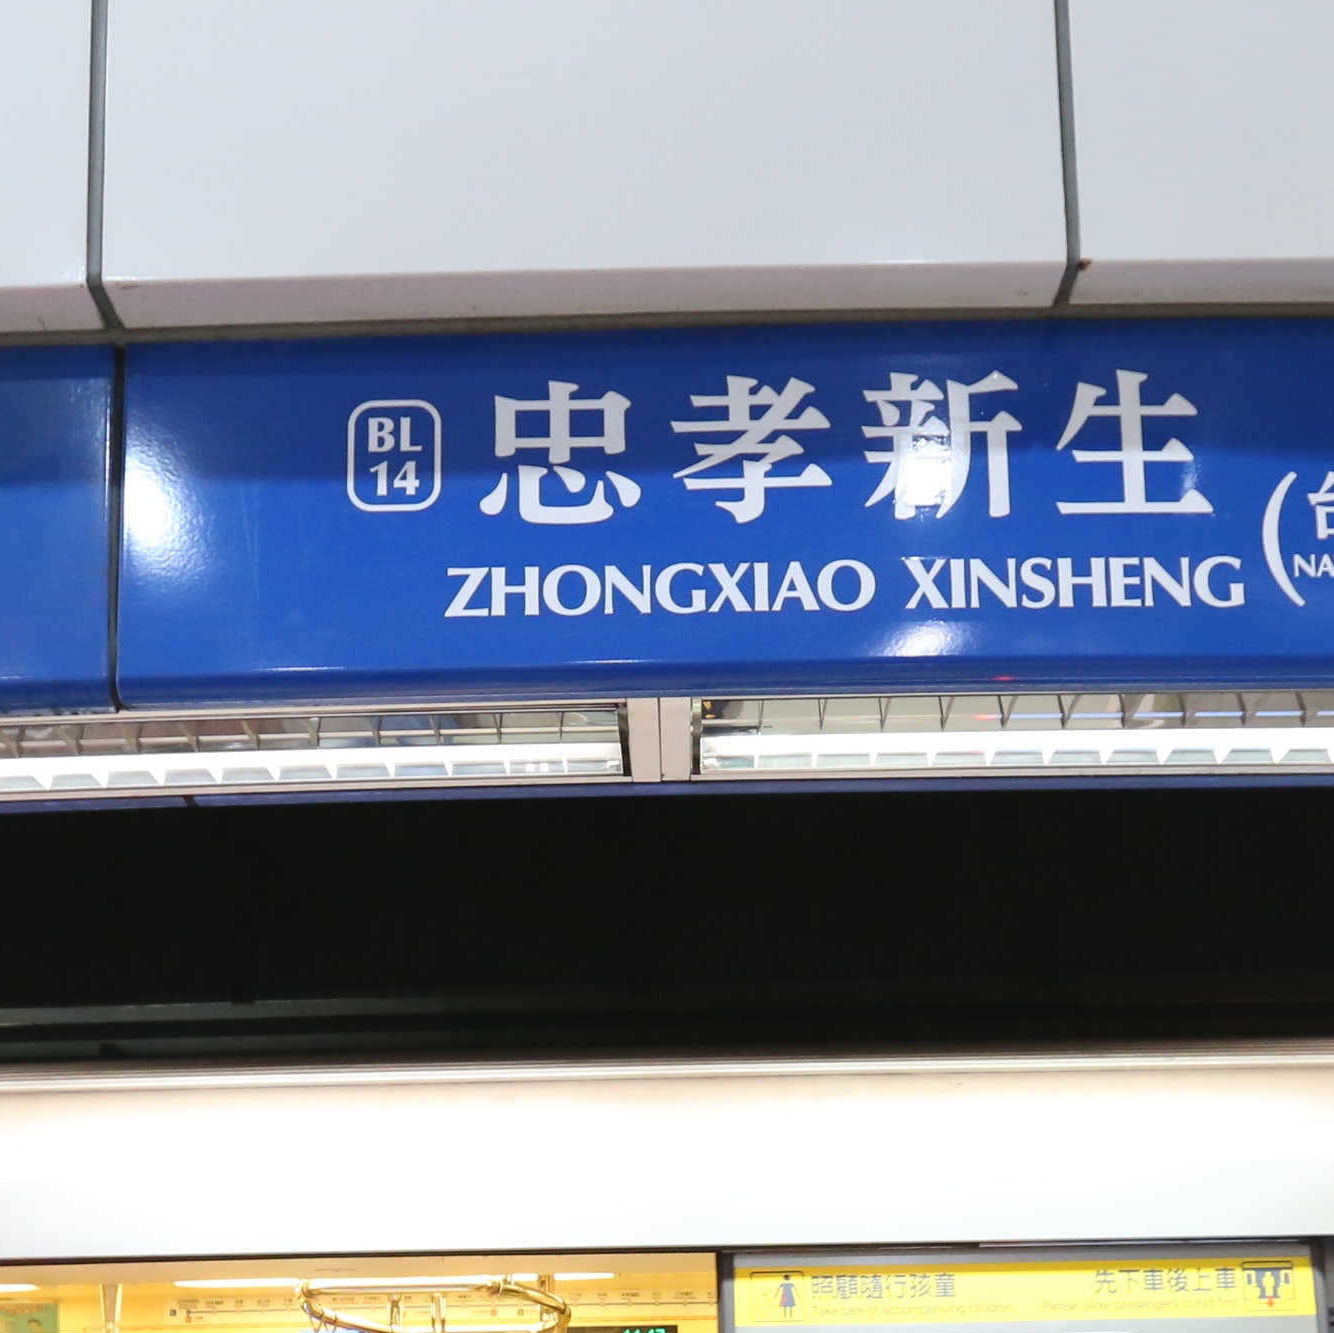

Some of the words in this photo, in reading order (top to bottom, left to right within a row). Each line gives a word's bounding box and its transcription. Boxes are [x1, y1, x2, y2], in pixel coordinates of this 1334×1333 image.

[368, 416, 423, 452] BL
[479, 370, 1214, 525] 忠孝新生
[370, 460, 420, 496] 14
[444, 559, 876, 618] ZHONGXIAO
[901, 555, 1245, 611] XINSHENG
[811, 1272, 956, 1299] 照顧隨行孩童
[1095, 1267, 1237, 1294] 先下車後上車
